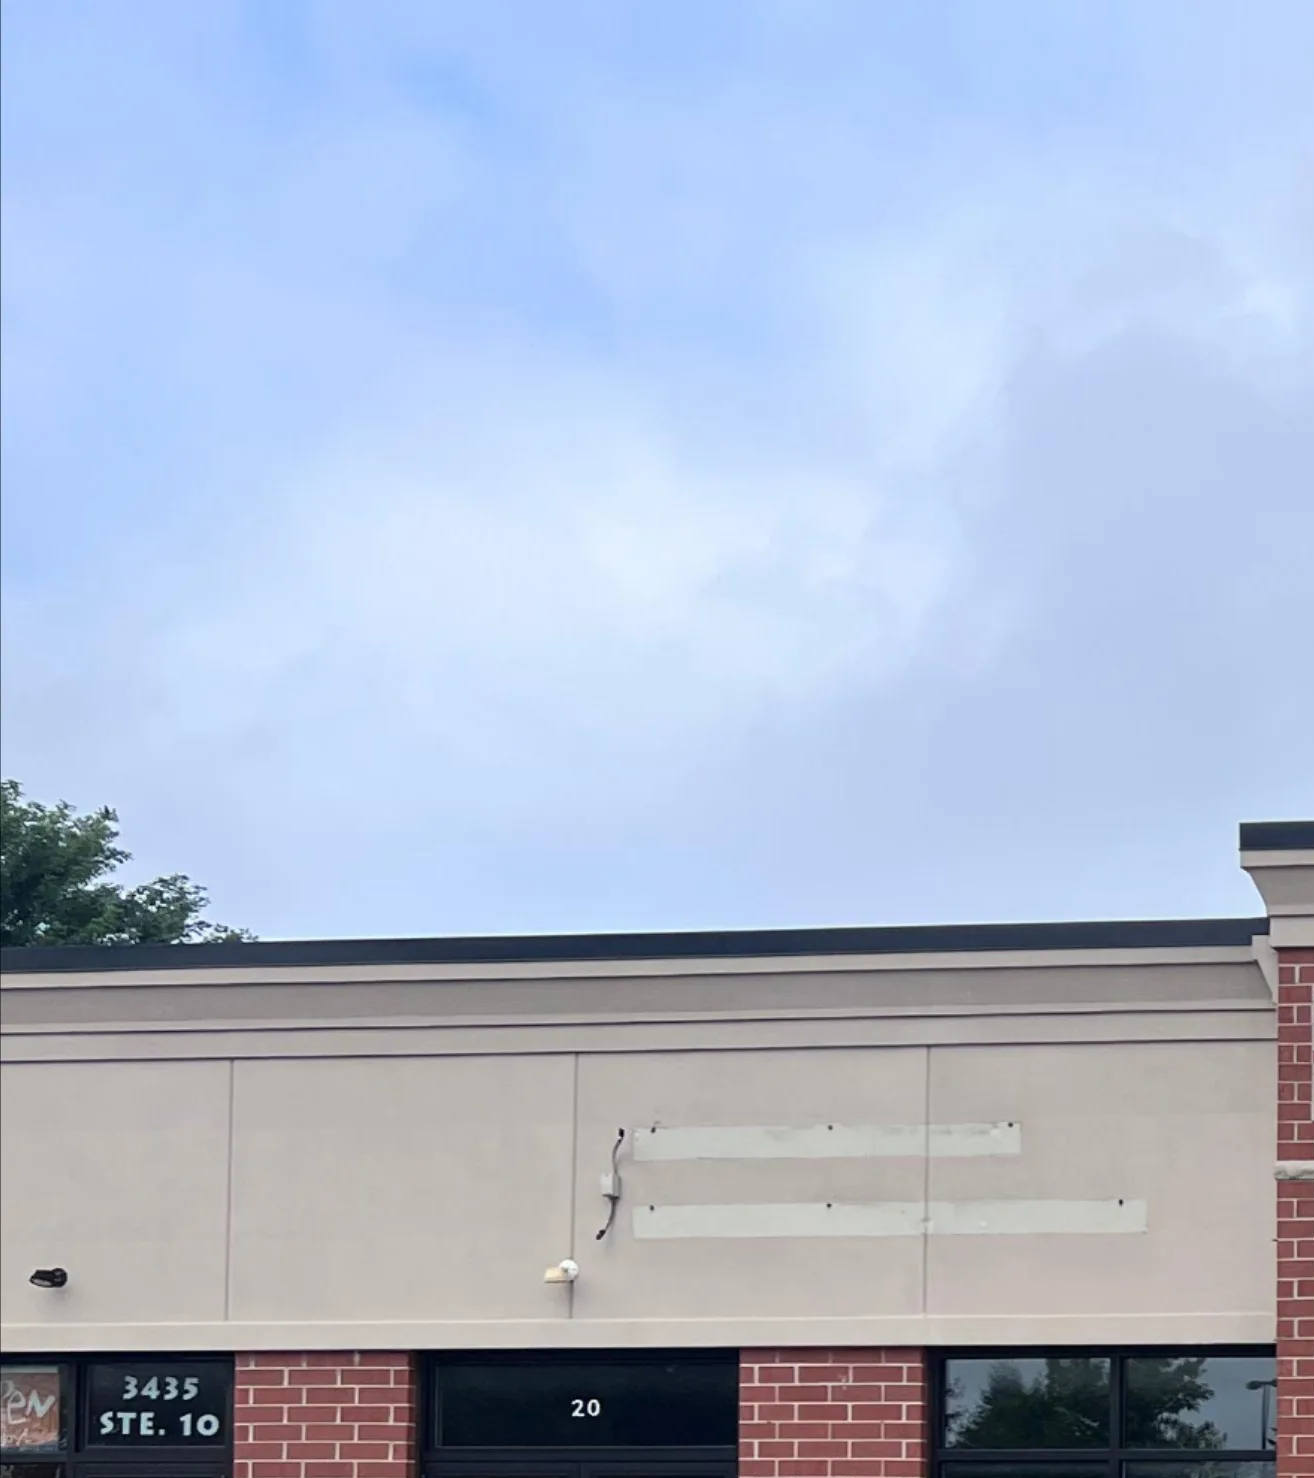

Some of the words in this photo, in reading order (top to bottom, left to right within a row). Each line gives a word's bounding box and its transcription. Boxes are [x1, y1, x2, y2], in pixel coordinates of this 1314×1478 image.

[122, 1375, 200, 1400] 3435
[571, 1399, 601, 1417] 20
[99, 1411, 166, 1436] STE.
[179, 1413, 220, 1436] 10
